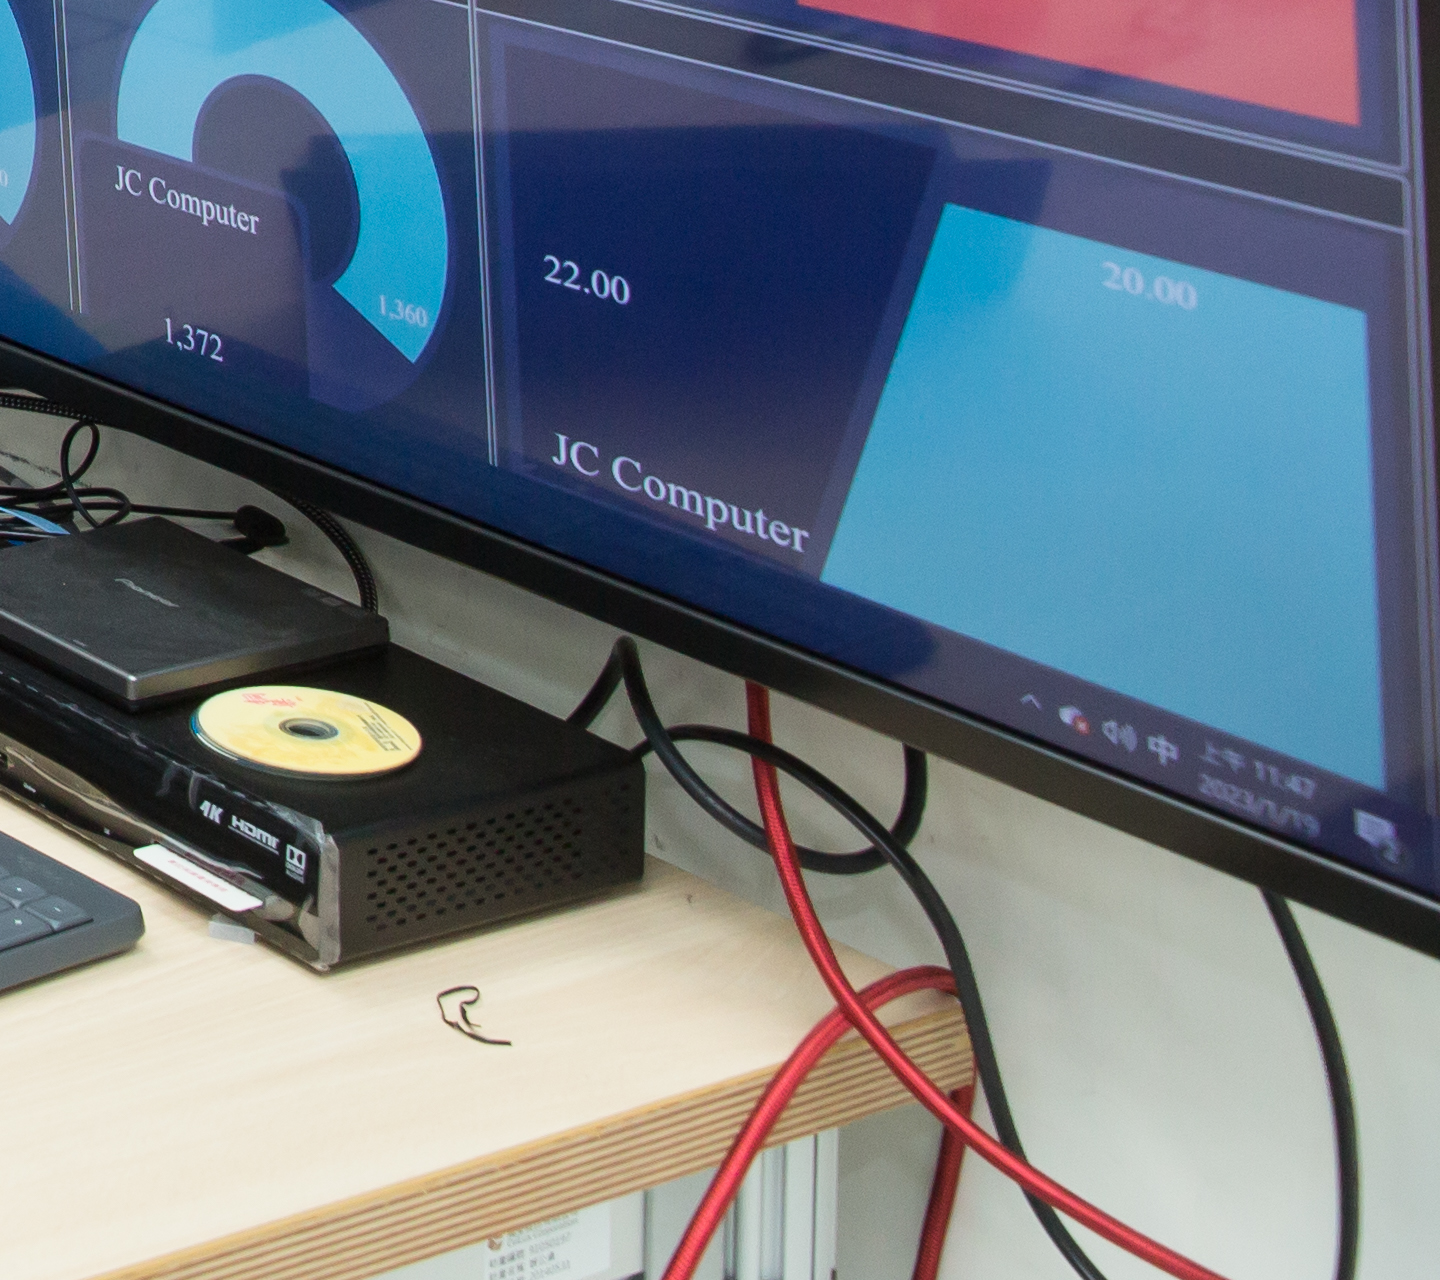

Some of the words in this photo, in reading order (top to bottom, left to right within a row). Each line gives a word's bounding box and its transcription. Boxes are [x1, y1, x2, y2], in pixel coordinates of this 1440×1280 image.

[115, 165, 143, 197] JC
[148, 176, 260, 235] Computer
[542, 255, 631, 306] 22.00
[1101, 260, 1198, 310] 20.00
[379, 295, 428, 327] 1,360
[164, 317, 224, 362] 1,372
[551, 432, 601, 480] JC
[611, 454, 810, 553] Computer
[199, 800, 224, 825] 4K
[231, 815, 280, 849] HDMI
